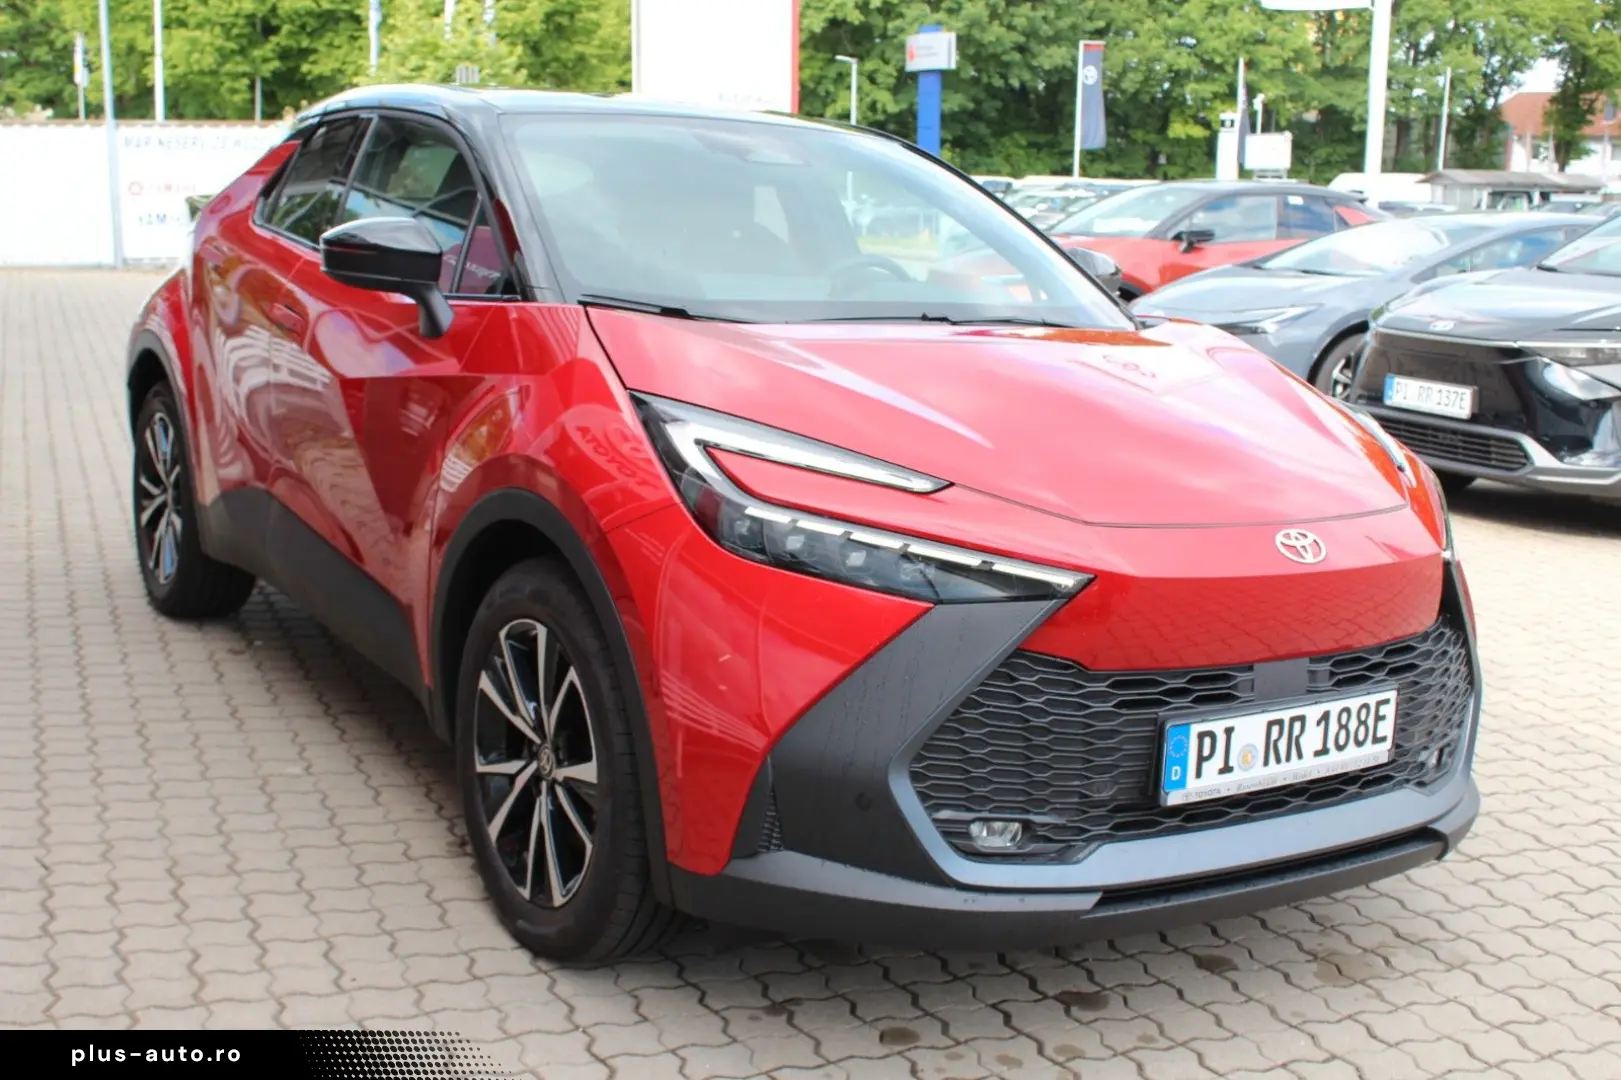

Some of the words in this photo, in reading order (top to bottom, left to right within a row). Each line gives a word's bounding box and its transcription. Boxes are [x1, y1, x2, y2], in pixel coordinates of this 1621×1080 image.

[1418, 385, 1433, 405] RR
[1436, 388, 1467, 411] 137E
[1194, 725, 1235, 779] PI
[1263, 714, 1306, 767] RR
[1313, 698, 1391, 758] 188E
[1171, 766, 1181, 781] D
